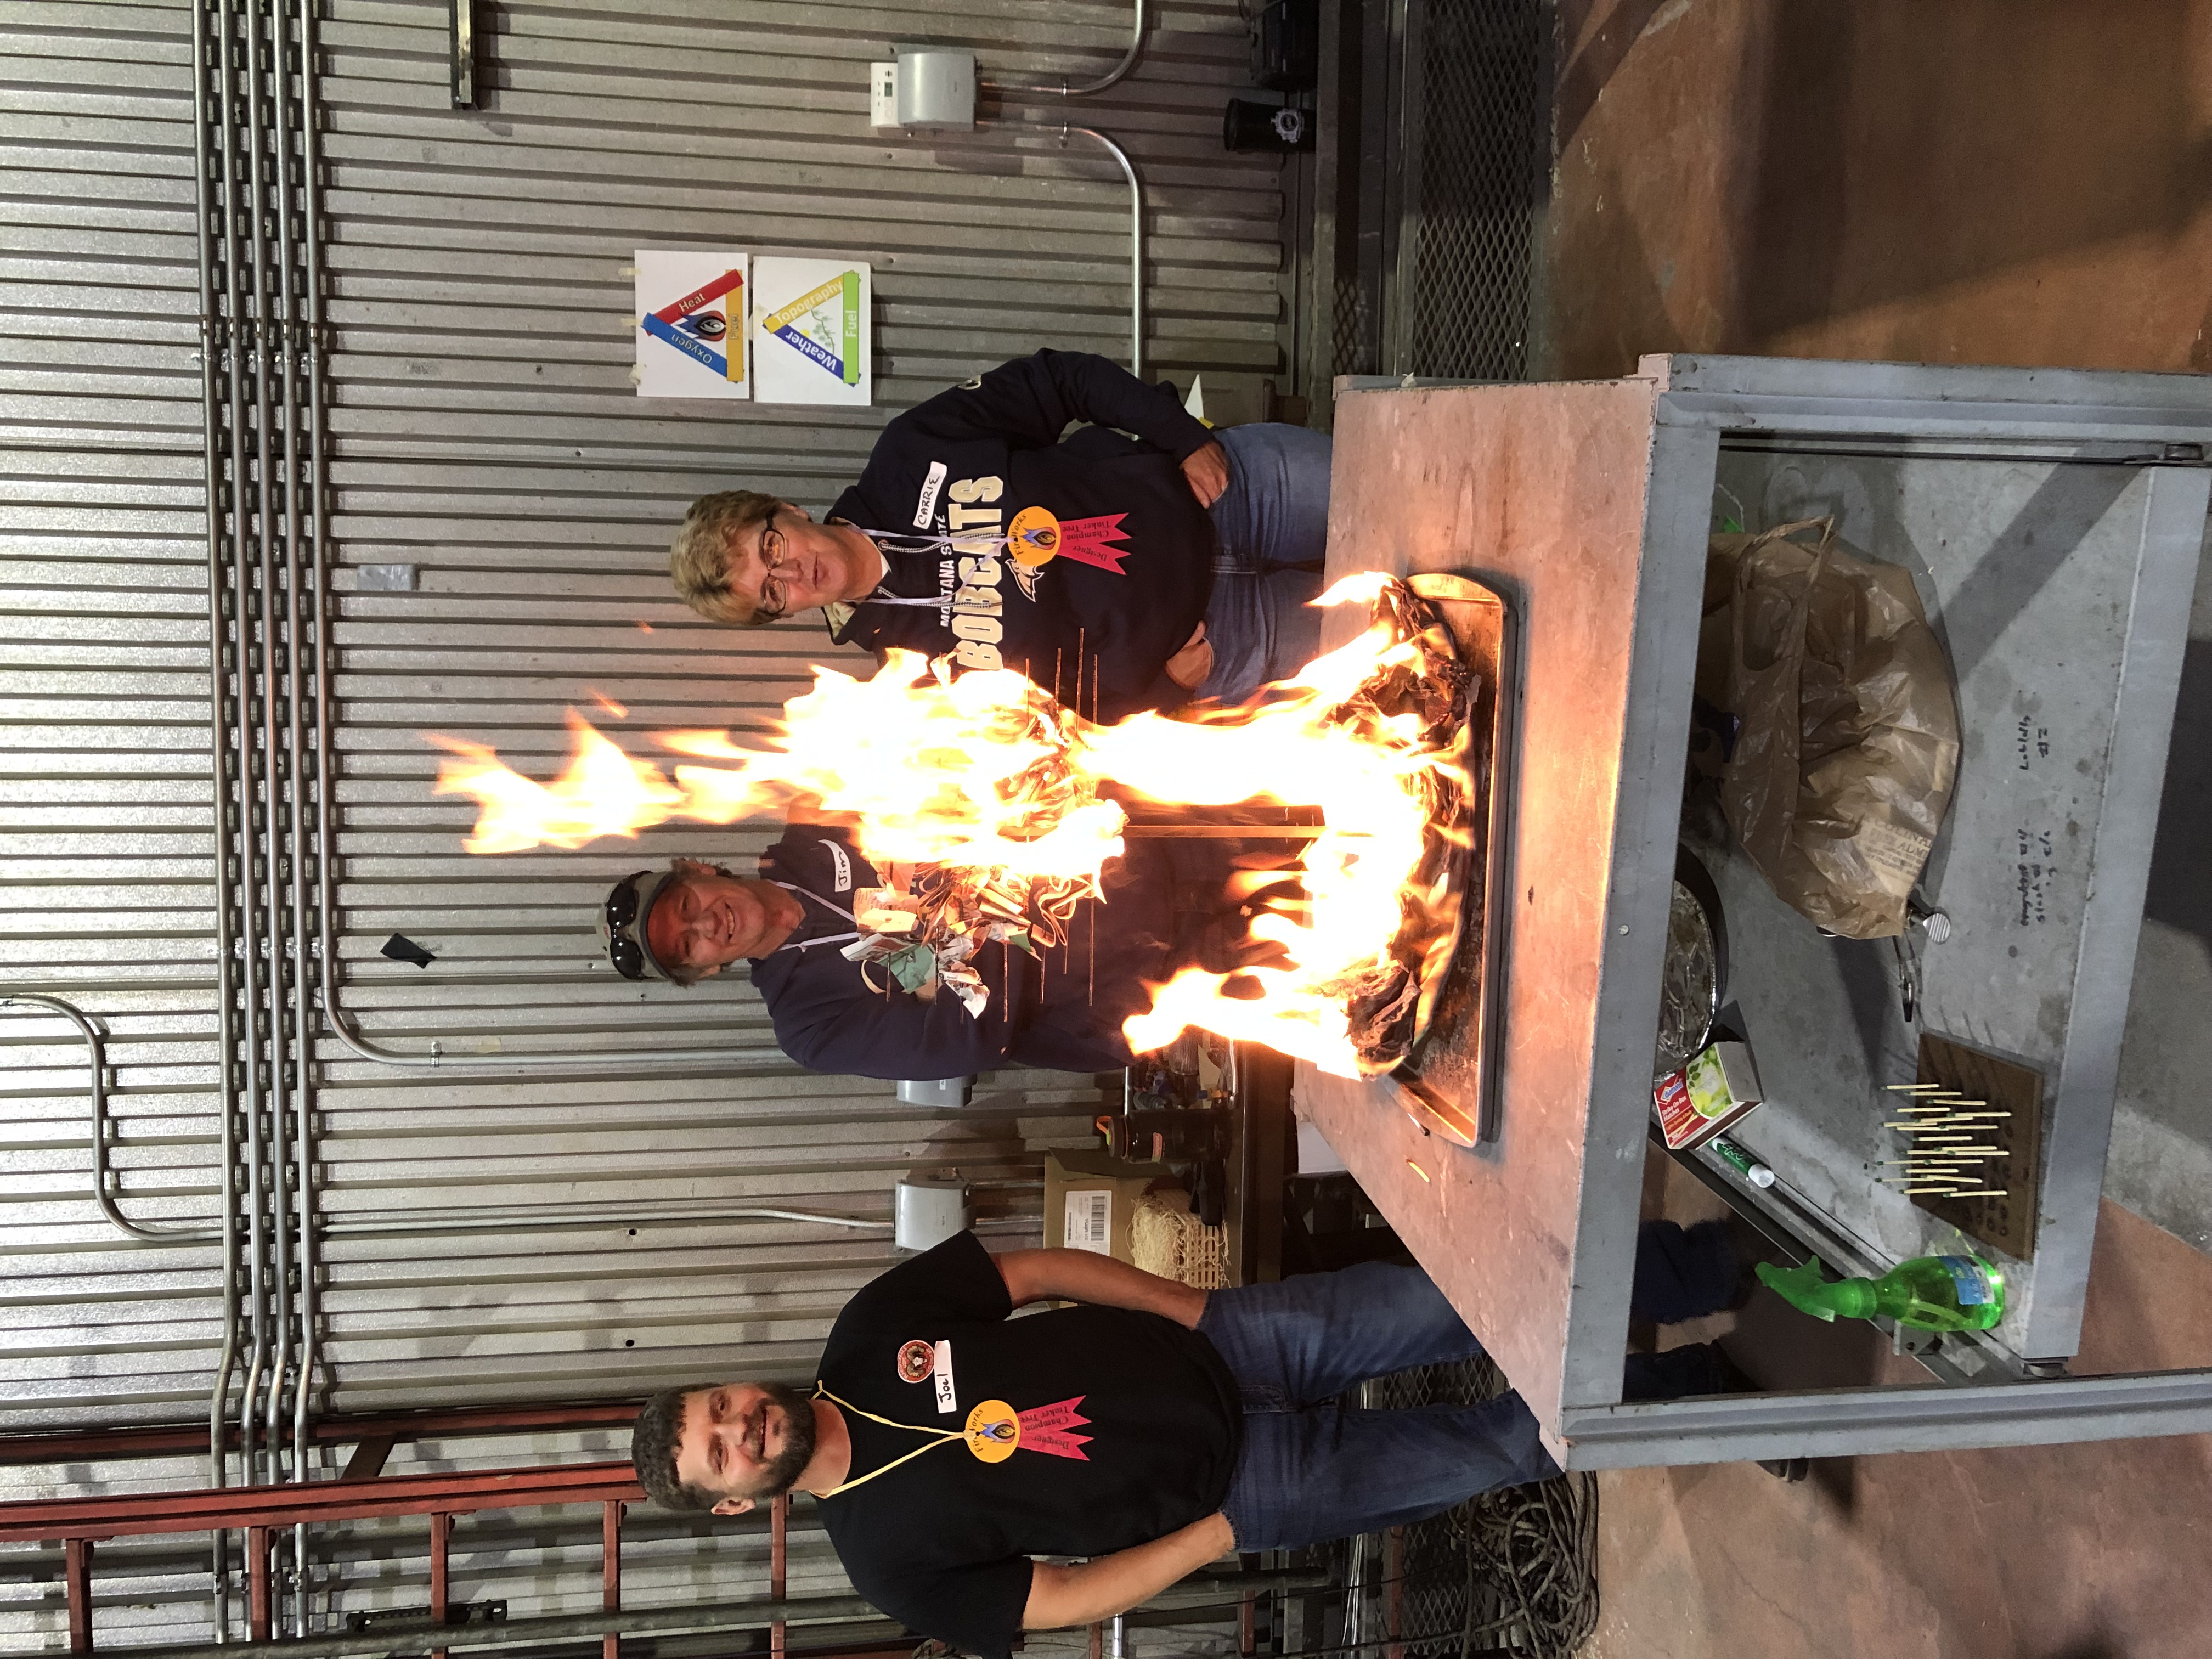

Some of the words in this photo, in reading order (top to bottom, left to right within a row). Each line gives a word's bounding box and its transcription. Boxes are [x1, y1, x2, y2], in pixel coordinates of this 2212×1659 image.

[678, 294, 706, 313] Heat
[776, 281, 844, 325] Topography
[729, 313, 740, 340] Fuel
[845, 309, 857, 337] Fuel
[671, 334, 713, 364] Oxygen
[785, 331, 838, 371] Weather
[918, 476, 940, 525] CARRIE
[1011, 514, 1026, 555] FirWorks
[1066, 530, 1109, 540] Champion
[1083, 521, 1111, 529] Tinker
[1073, 545, 1108, 561] Designer
[948, 476, 1004, 671] BOBCATS
[838, 851, 847, 887] Jim
[1662, 1105, 1673, 1116] Strike
[1678, 1095, 1687, 1104] Box
[936, 1373, 952, 1403] Joel
[969, 1409, 984, 1453] FirWorks
